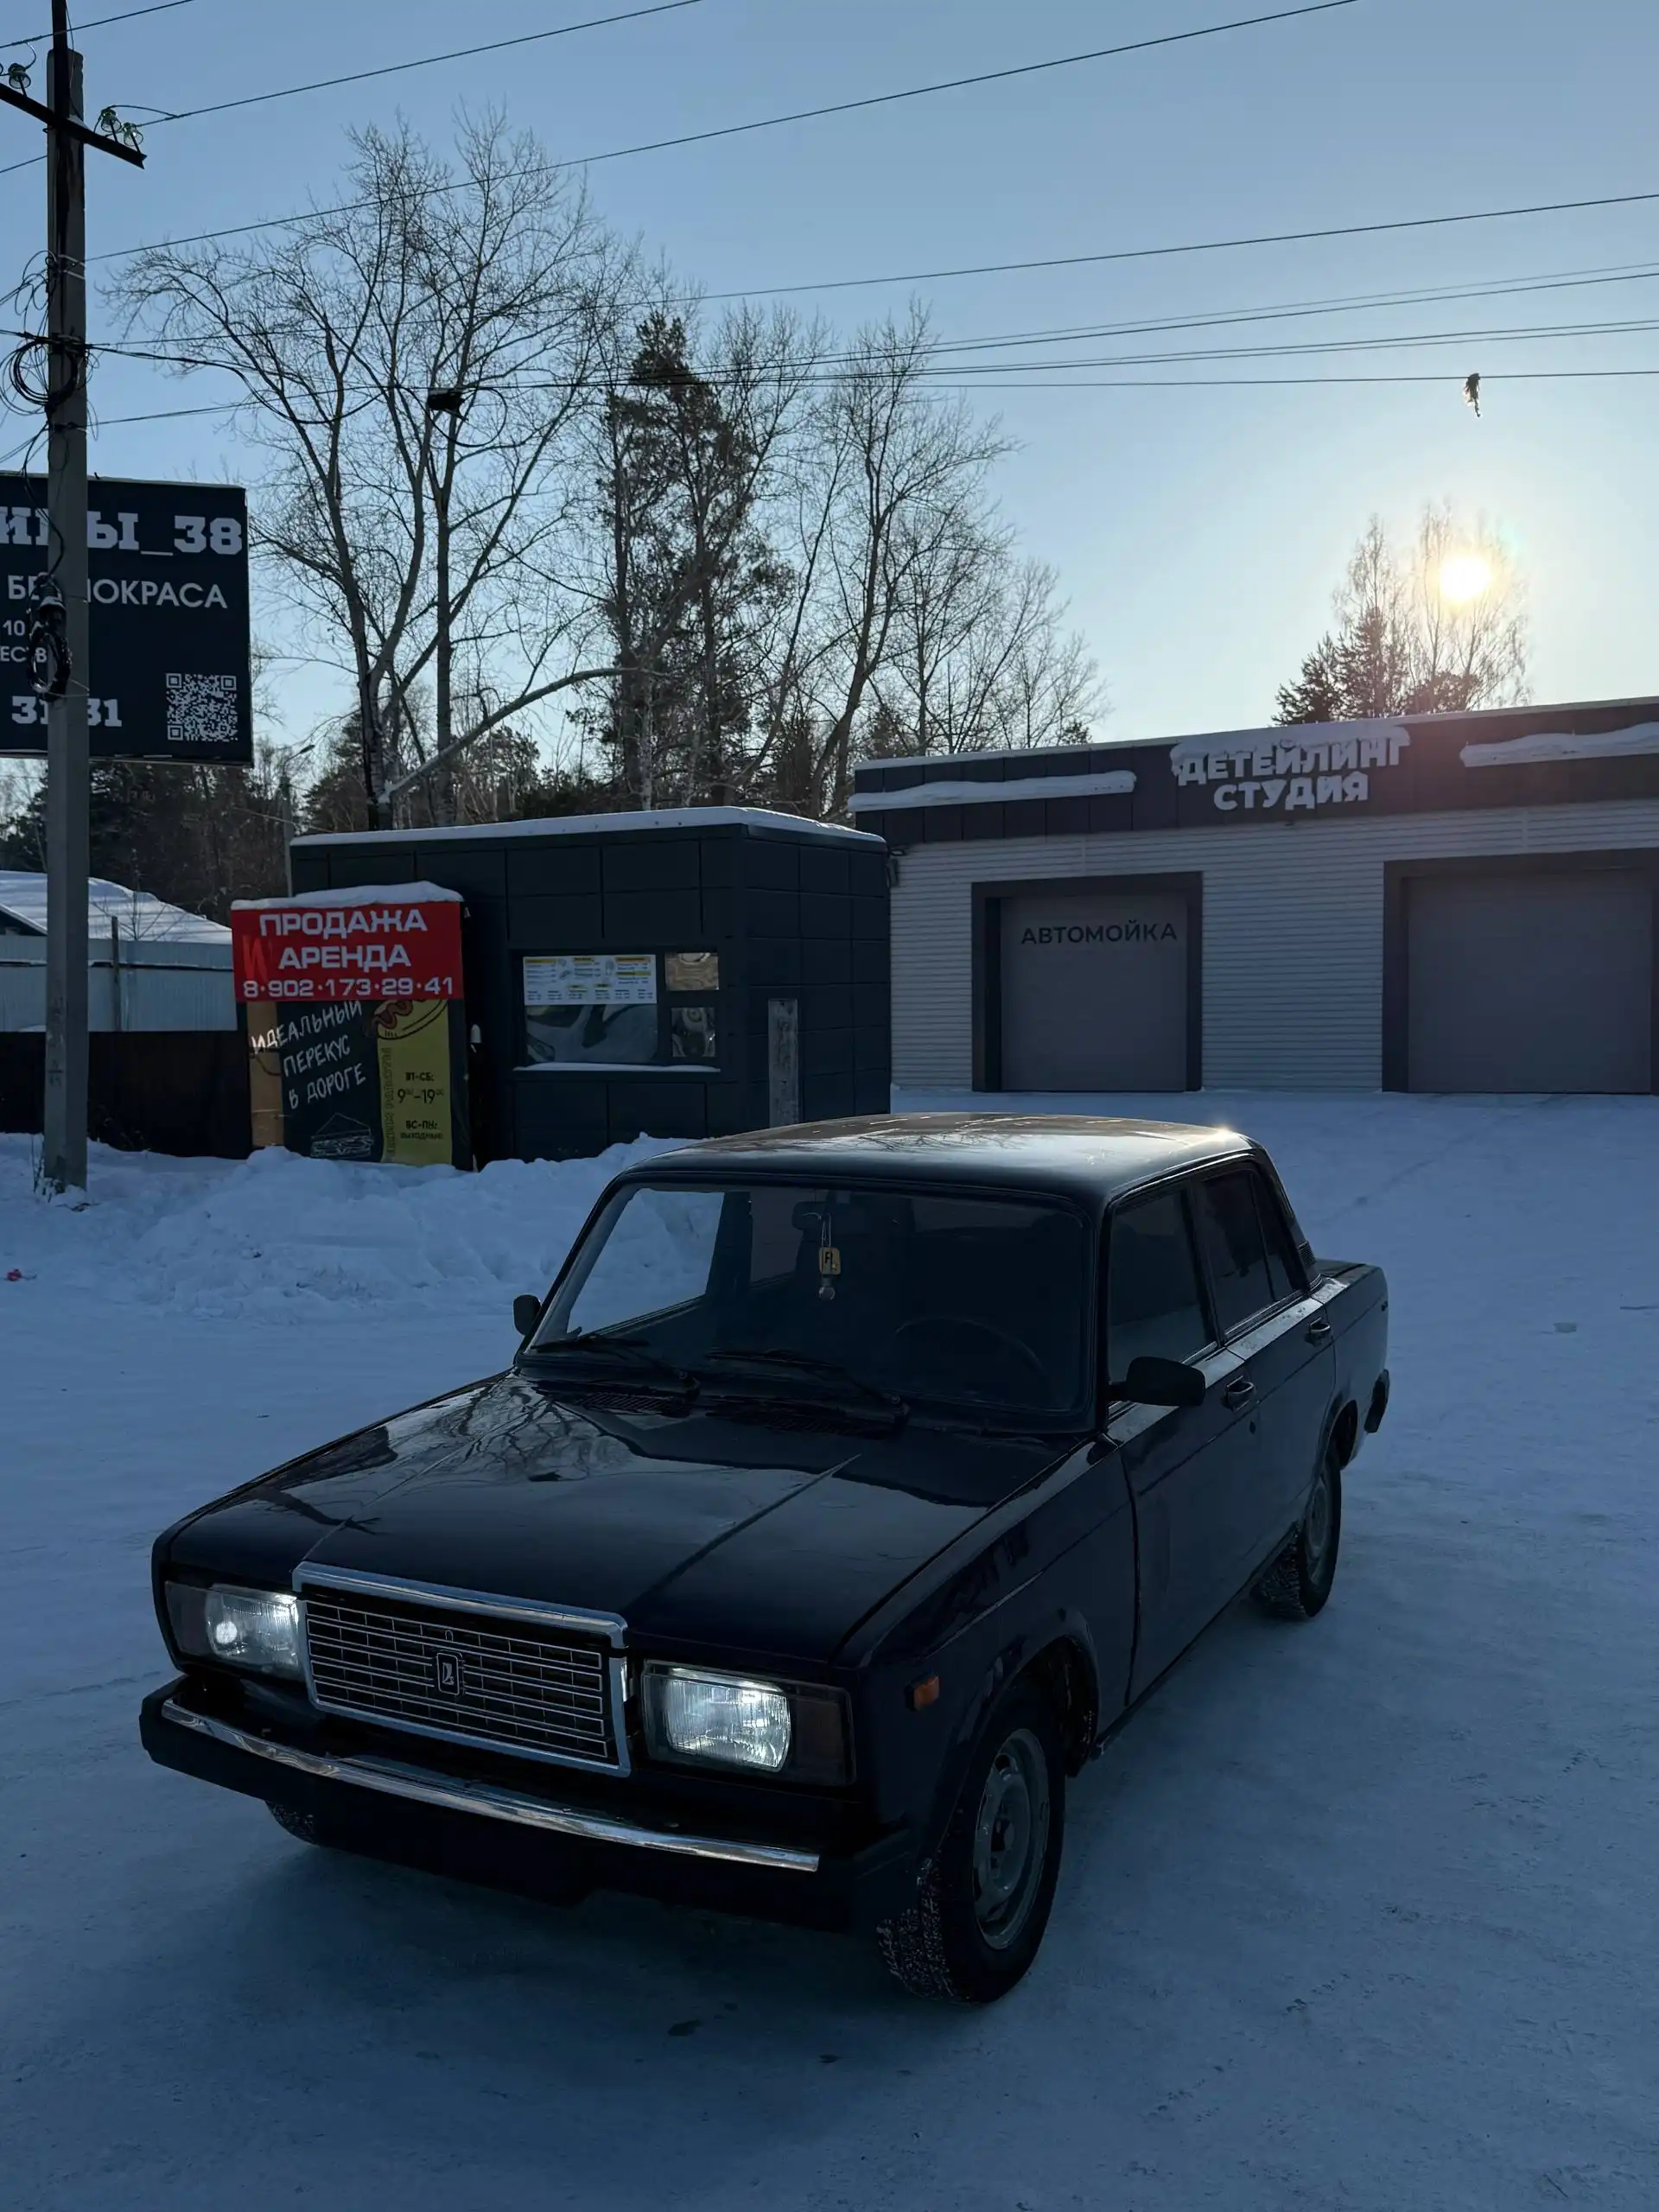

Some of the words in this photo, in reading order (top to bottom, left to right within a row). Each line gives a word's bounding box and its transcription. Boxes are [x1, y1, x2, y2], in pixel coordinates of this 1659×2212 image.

[1177, 737, 1403, 786] ДЕТЕЙЛИНГ
[1213, 771, 1369, 810] СТУДИЯ
[259, 909, 428, 939] ПРОДАЖА
[1020, 919, 1178, 945] АВТОМОЙКА
[278, 944, 411, 973] АРЕНДА
[251, 1000, 363, 1054] ИДЕАЛЬНЫЙ
[283, 1034, 351, 1077] ПЕРЕКУС
[288, 1088, 300, 1109] В
[307, 1063, 367, 1103] ДОРОГЕ
